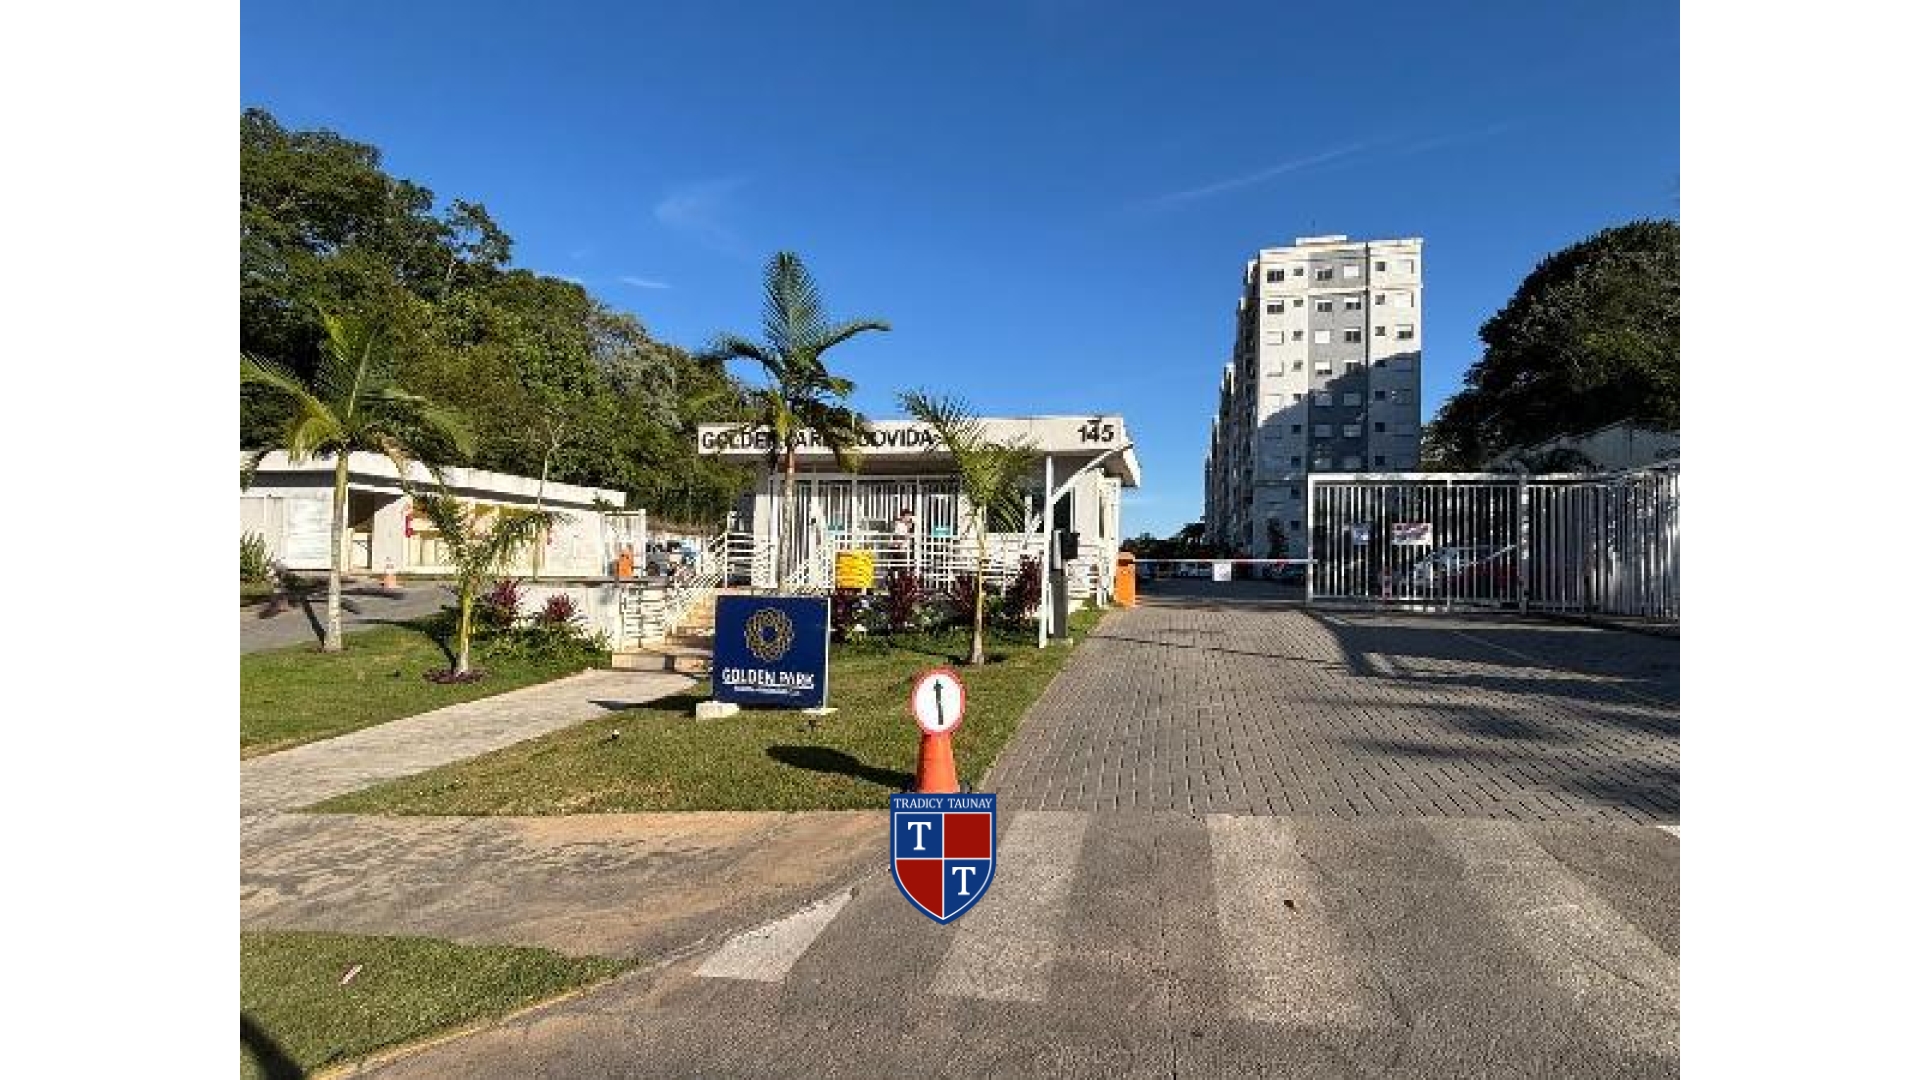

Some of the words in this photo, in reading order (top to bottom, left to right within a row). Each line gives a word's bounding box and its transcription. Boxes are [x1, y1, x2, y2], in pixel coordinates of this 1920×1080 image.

[703, 431, 778, 449] GOLDE
[786, 430, 834, 448] AR
[1078, 424, 1115, 442] 145
[722, 667, 776, 684] GOLDEN
[780, 671, 815, 687] PARK
